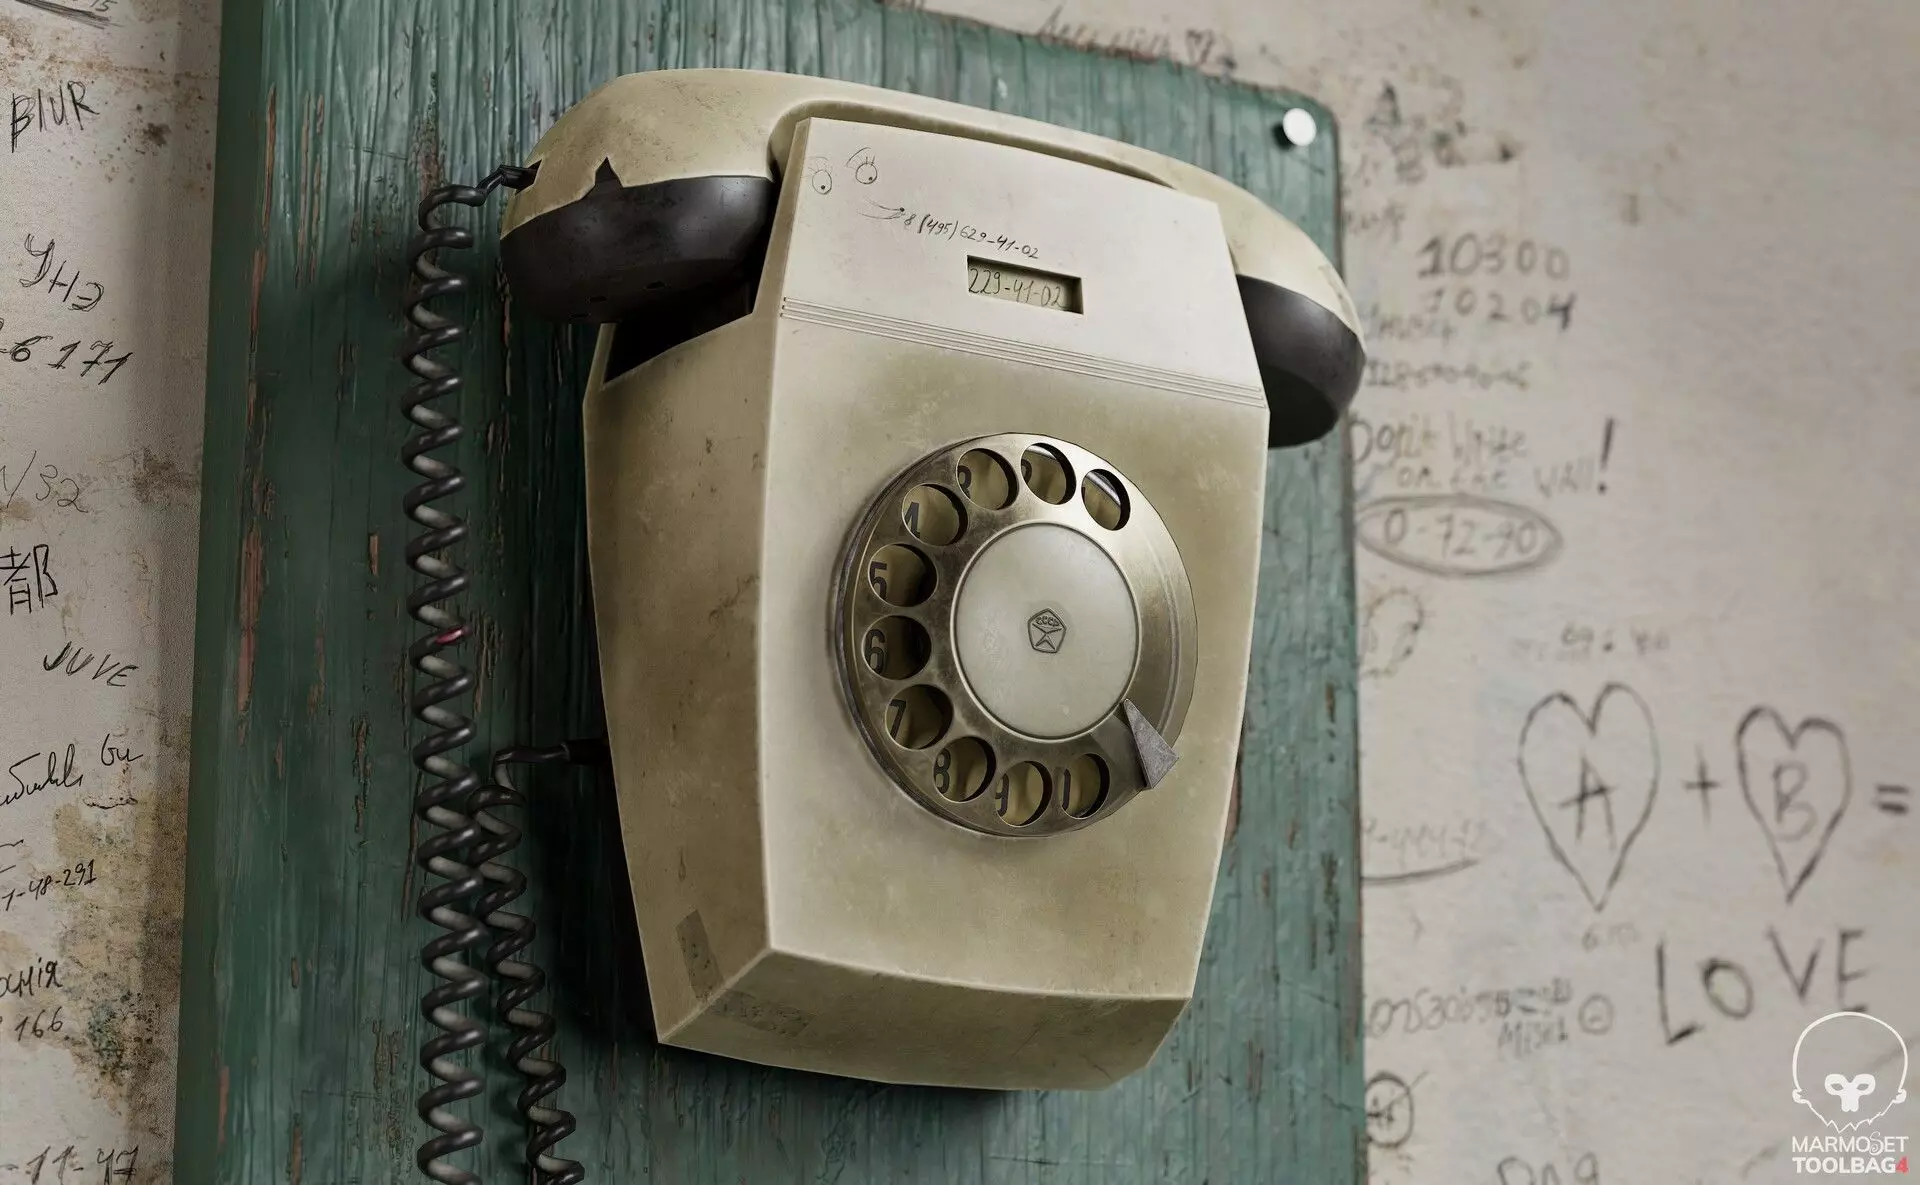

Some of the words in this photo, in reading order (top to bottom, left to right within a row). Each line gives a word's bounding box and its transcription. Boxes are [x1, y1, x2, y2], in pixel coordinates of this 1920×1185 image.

[968, 267, 1068, 310] 229-41-02
[869, 560, 888, 601] 5
[865, 628, 886, 675] 6
[889, 699, 907, 740] 7
[933, 749, 950, 794] 8
[1656, 926, 1870, 1045] LOVE
